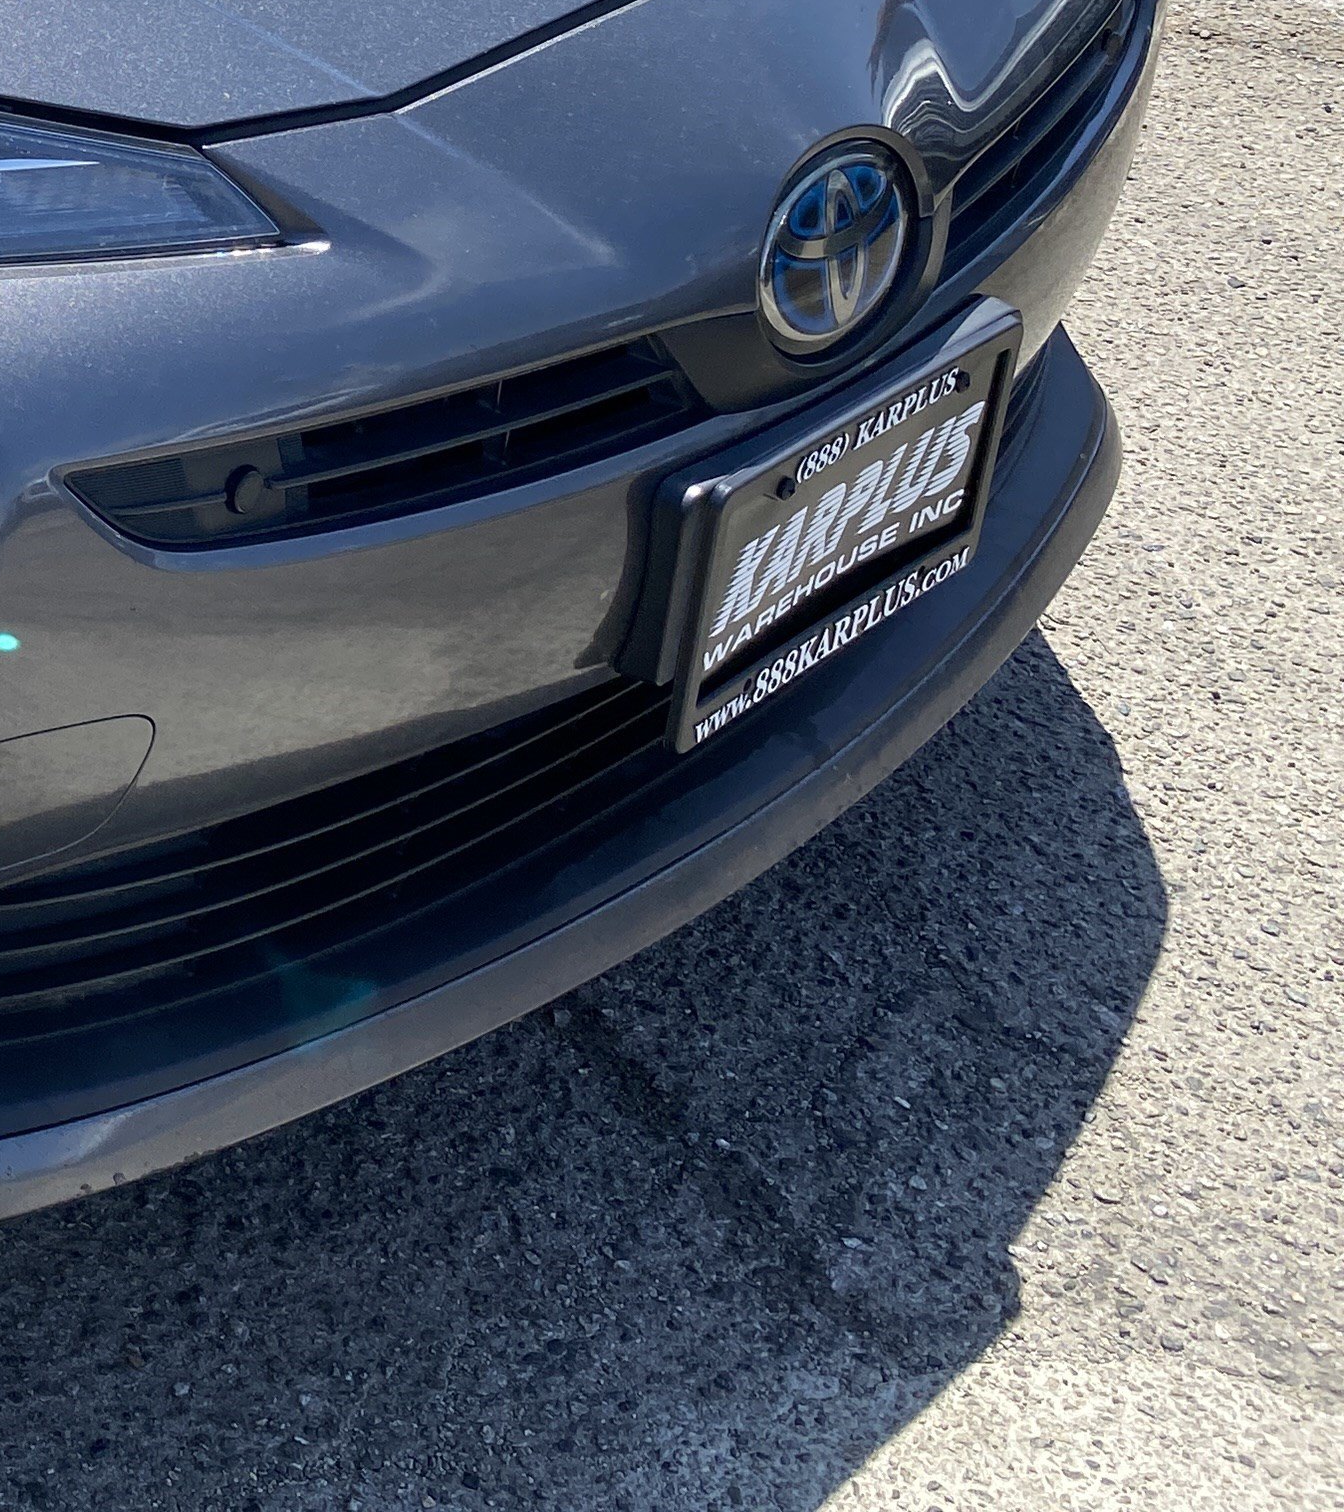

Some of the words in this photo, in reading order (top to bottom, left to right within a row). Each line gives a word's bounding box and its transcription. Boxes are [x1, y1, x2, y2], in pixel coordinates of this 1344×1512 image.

[796, 432, 850, 484] (888)
[853, 367, 960, 451] KARPLUS
[702, 521, 901, 672] WAREHOUSE
[908, 488, 965, 534] INC
[708, 400, 986, 639] KARPLUS
